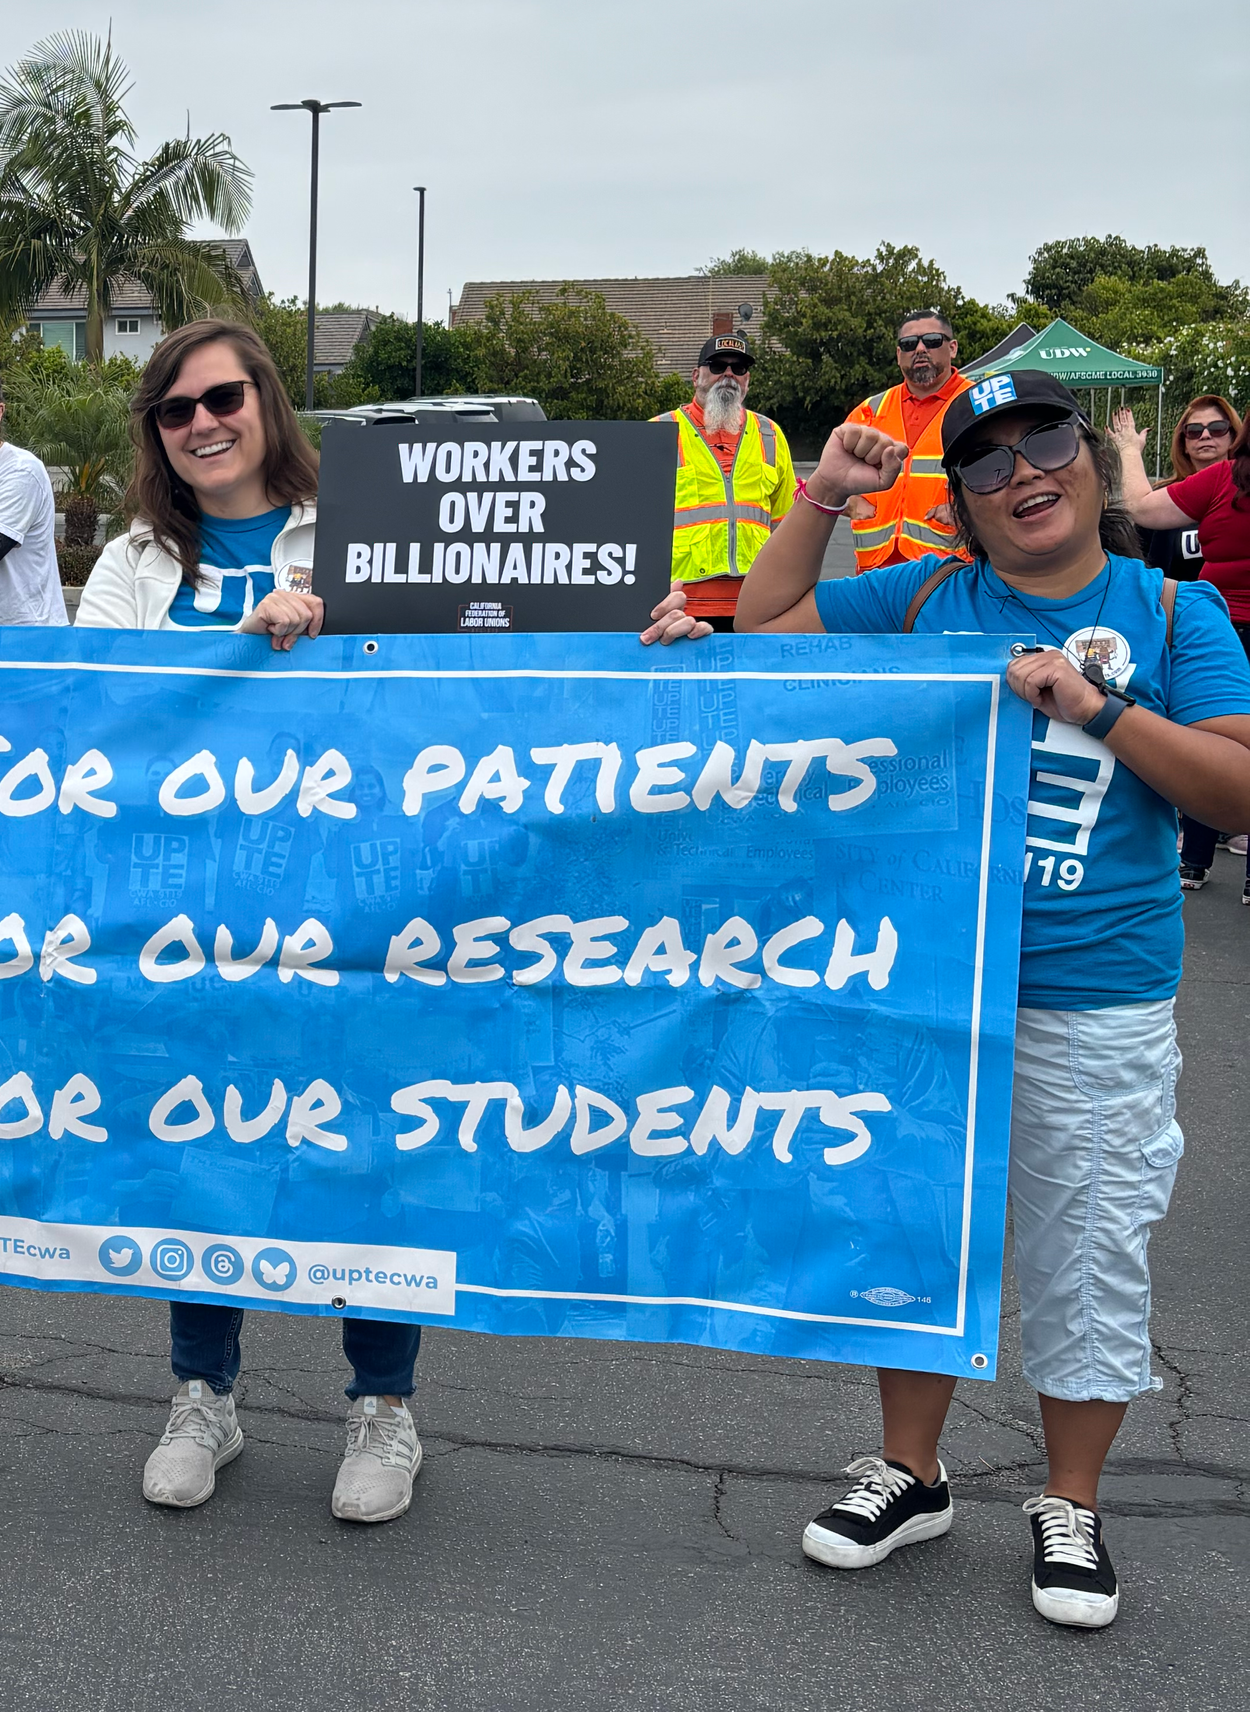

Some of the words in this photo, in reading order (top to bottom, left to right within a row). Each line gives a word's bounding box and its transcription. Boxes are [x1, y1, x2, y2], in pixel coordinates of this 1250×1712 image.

[1038, 347, 1088, 359] UDW
[972, 374, 1011, 400] UP
[1107, 371, 1134, 379] LOCAL
[1137, 370, 1157, 378] 3930
[974, 387, 1013, 410] TE
[398, 440, 596, 482] WORKERS
[438, 491, 545, 533] OVER
[345, 542, 637, 585] BILLIONAIRES!
[470, 602, 502, 610] CALIFORNIA
[460, 618, 483, 627] LABOR
[484, 618, 510, 628] UNIONS
[158, 748, 358, 820] OUR
[401, 738, 897, 817] PATIENTS
[139, 914, 340, 987] OUR
[383, 915, 897, 991] RESEARCH
[149, 1074, 348, 1152] OUR
[390, 1079, 892, 1166] STUDENTS
[308, 1264, 438, 1290] @uptecwa
